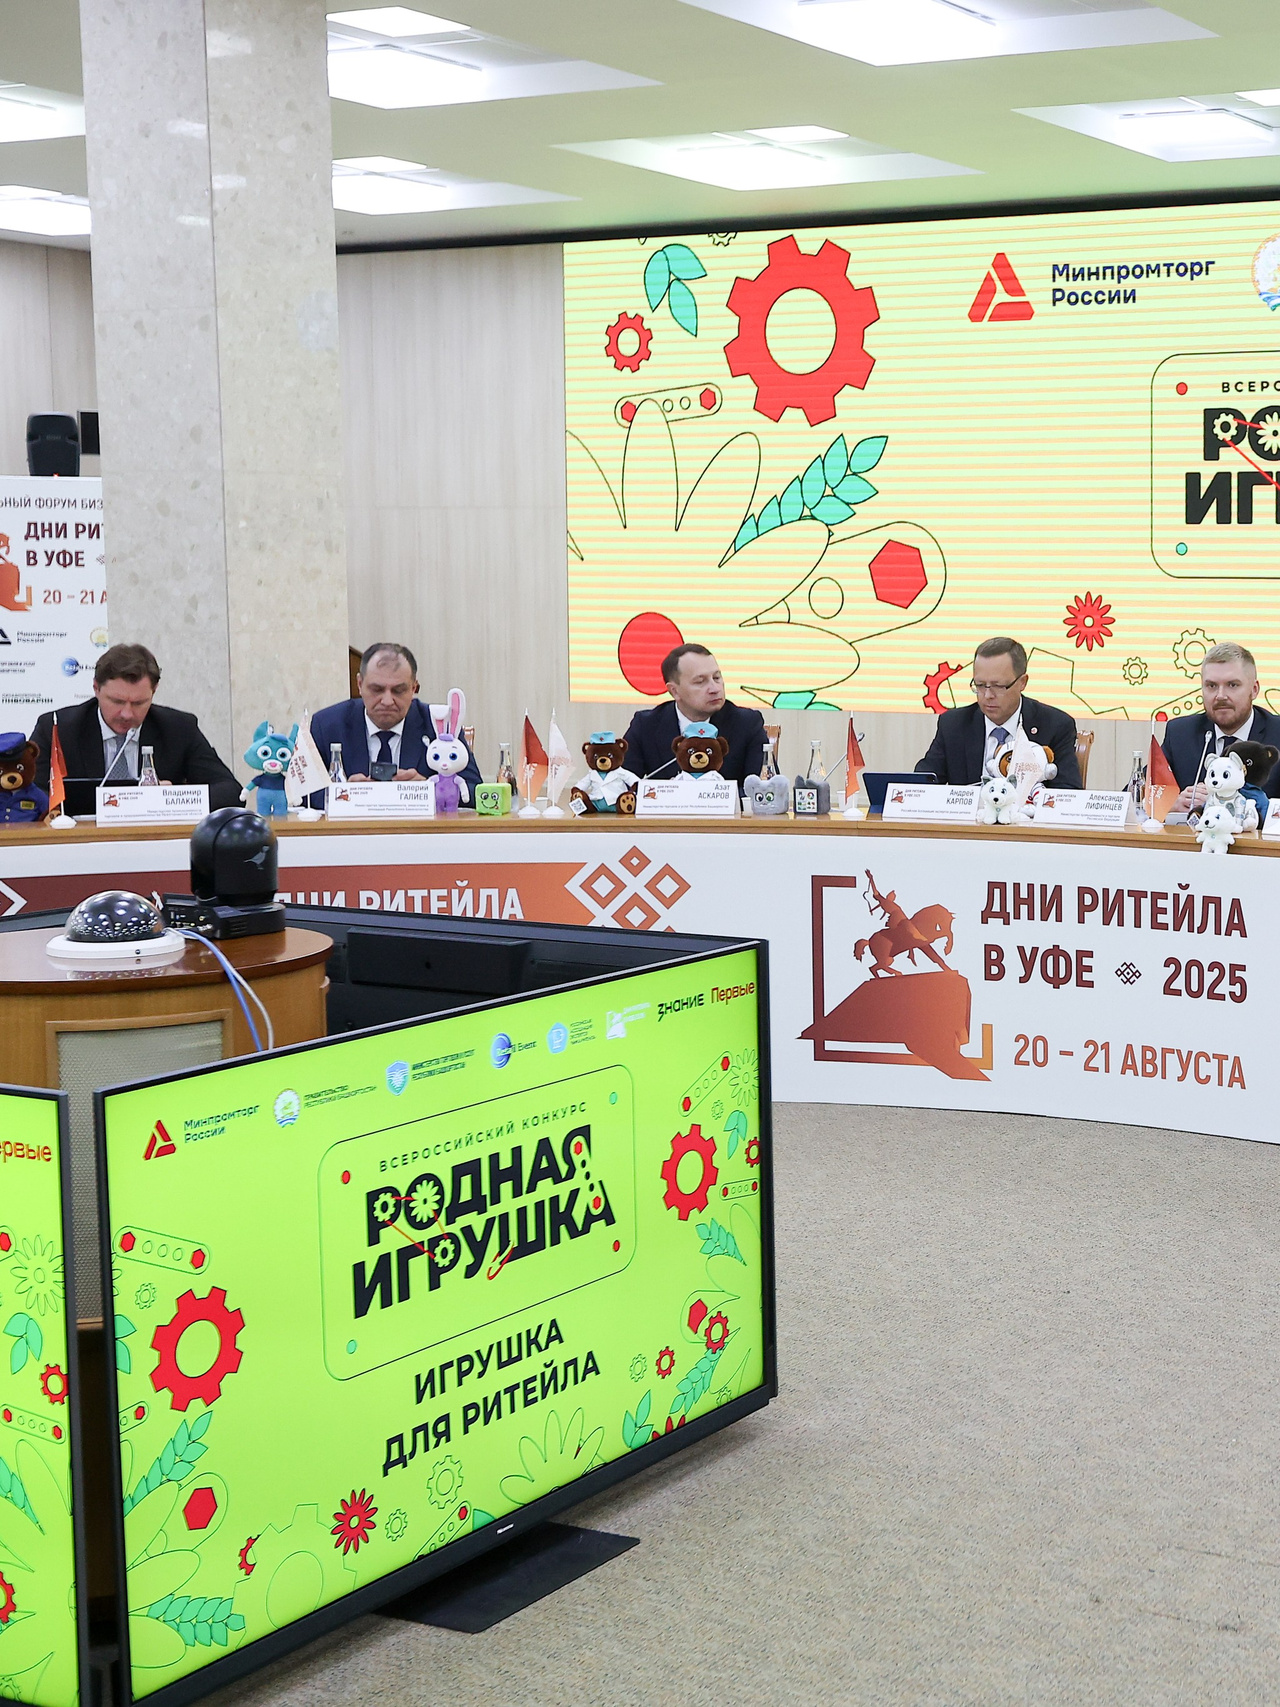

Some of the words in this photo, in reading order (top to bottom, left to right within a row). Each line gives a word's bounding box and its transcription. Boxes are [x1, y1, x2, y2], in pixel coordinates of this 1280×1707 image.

[1051, 258, 1216, 284] Минпромторг
[1051, 287, 1137, 307] России
[35, 497, 77, 509] ФОРУМ
[24, 522, 67, 541] ДНИ
[75, 522, 104, 540] РИ
[26, 550, 38, 567] В
[44, 549, 85, 568] УФЕ
[43, 589, 61, 604] 20
[80, 589, 95, 605] 21
[163, 788, 202, 797] Владимир
[397, 784, 429, 793] Валерий
[949, 789, 974, 797] Андрей
[1089, 793, 1124, 802] Александр
[165, 798, 202, 806] БАЛАКИН
[946, 798, 973, 806] КАРПОВ
[1085, 802, 1122, 811] ЛИФИНЦЕВ
[358, 880, 525, 919] РИТЕЙЛА
[981, 880, 1063, 926] ДНИ
[1077, 883, 1247, 938] РИТЕЙЛА
[984, 944, 1005, 982] В
[1017, 944, 1094, 989] УФЕ
[1163, 956, 1247, 1003] 2025
[710, 982, 755, 1005] Первые
[1014, 1034, 1049, 1068] 20
[1084, 1039, 1110, 1073] 21
[1120, 1043, 1246, 1090] АВГУСТА
[184, 1105, 260, 1130] Минпромторг
[184, 1126, 226, 1143] России
[379, 1121, 515, 1172] ВСЕРОССИЙСКИЙ
[522, 1102, 587, 1130] КОНКУРС
[366, 1124, 591, 1247] РОДНАЯ
[352, 1179, 616, 1319] ИГРУШКА
[415, 1318, 564, 1404] ИГРУШКА
[382, 1413, 452, 1477] ДЛЯ
[462, 1351, 600, 1435] РИТЕЙЛА
